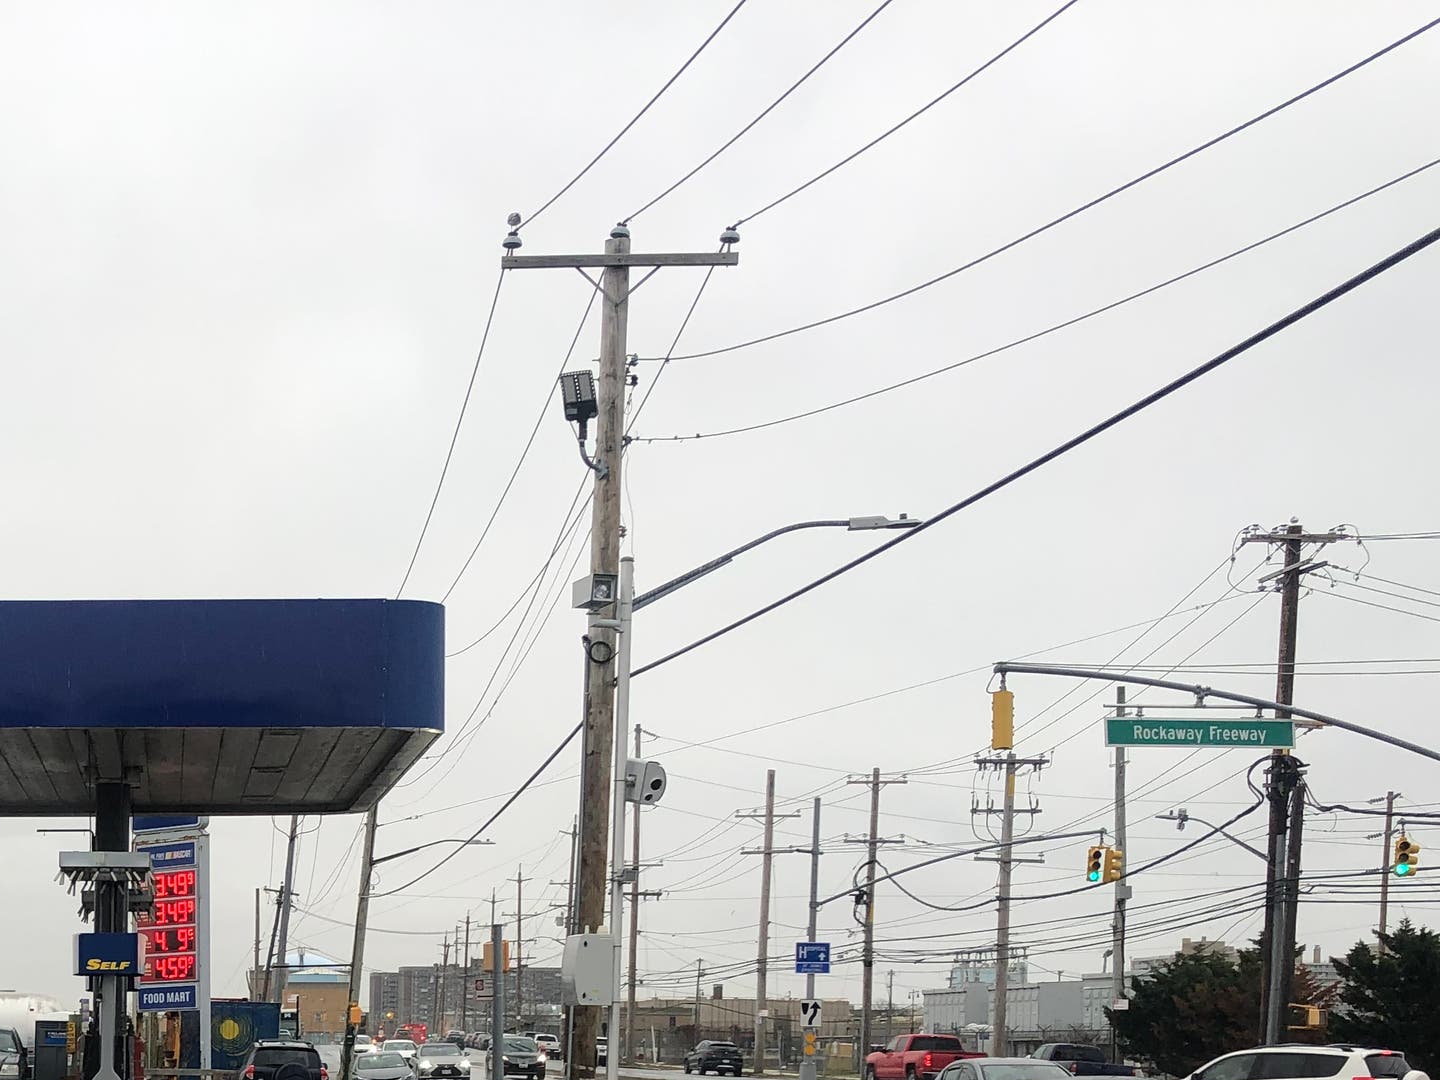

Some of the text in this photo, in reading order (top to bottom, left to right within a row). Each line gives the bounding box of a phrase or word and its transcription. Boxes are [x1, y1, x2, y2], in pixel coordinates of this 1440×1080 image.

[1133, 725, 1266, 744] Rockaway Freeway
[86, 958, 131, 971] SELF
[143, 991, 190, 1004] FOOD MART
